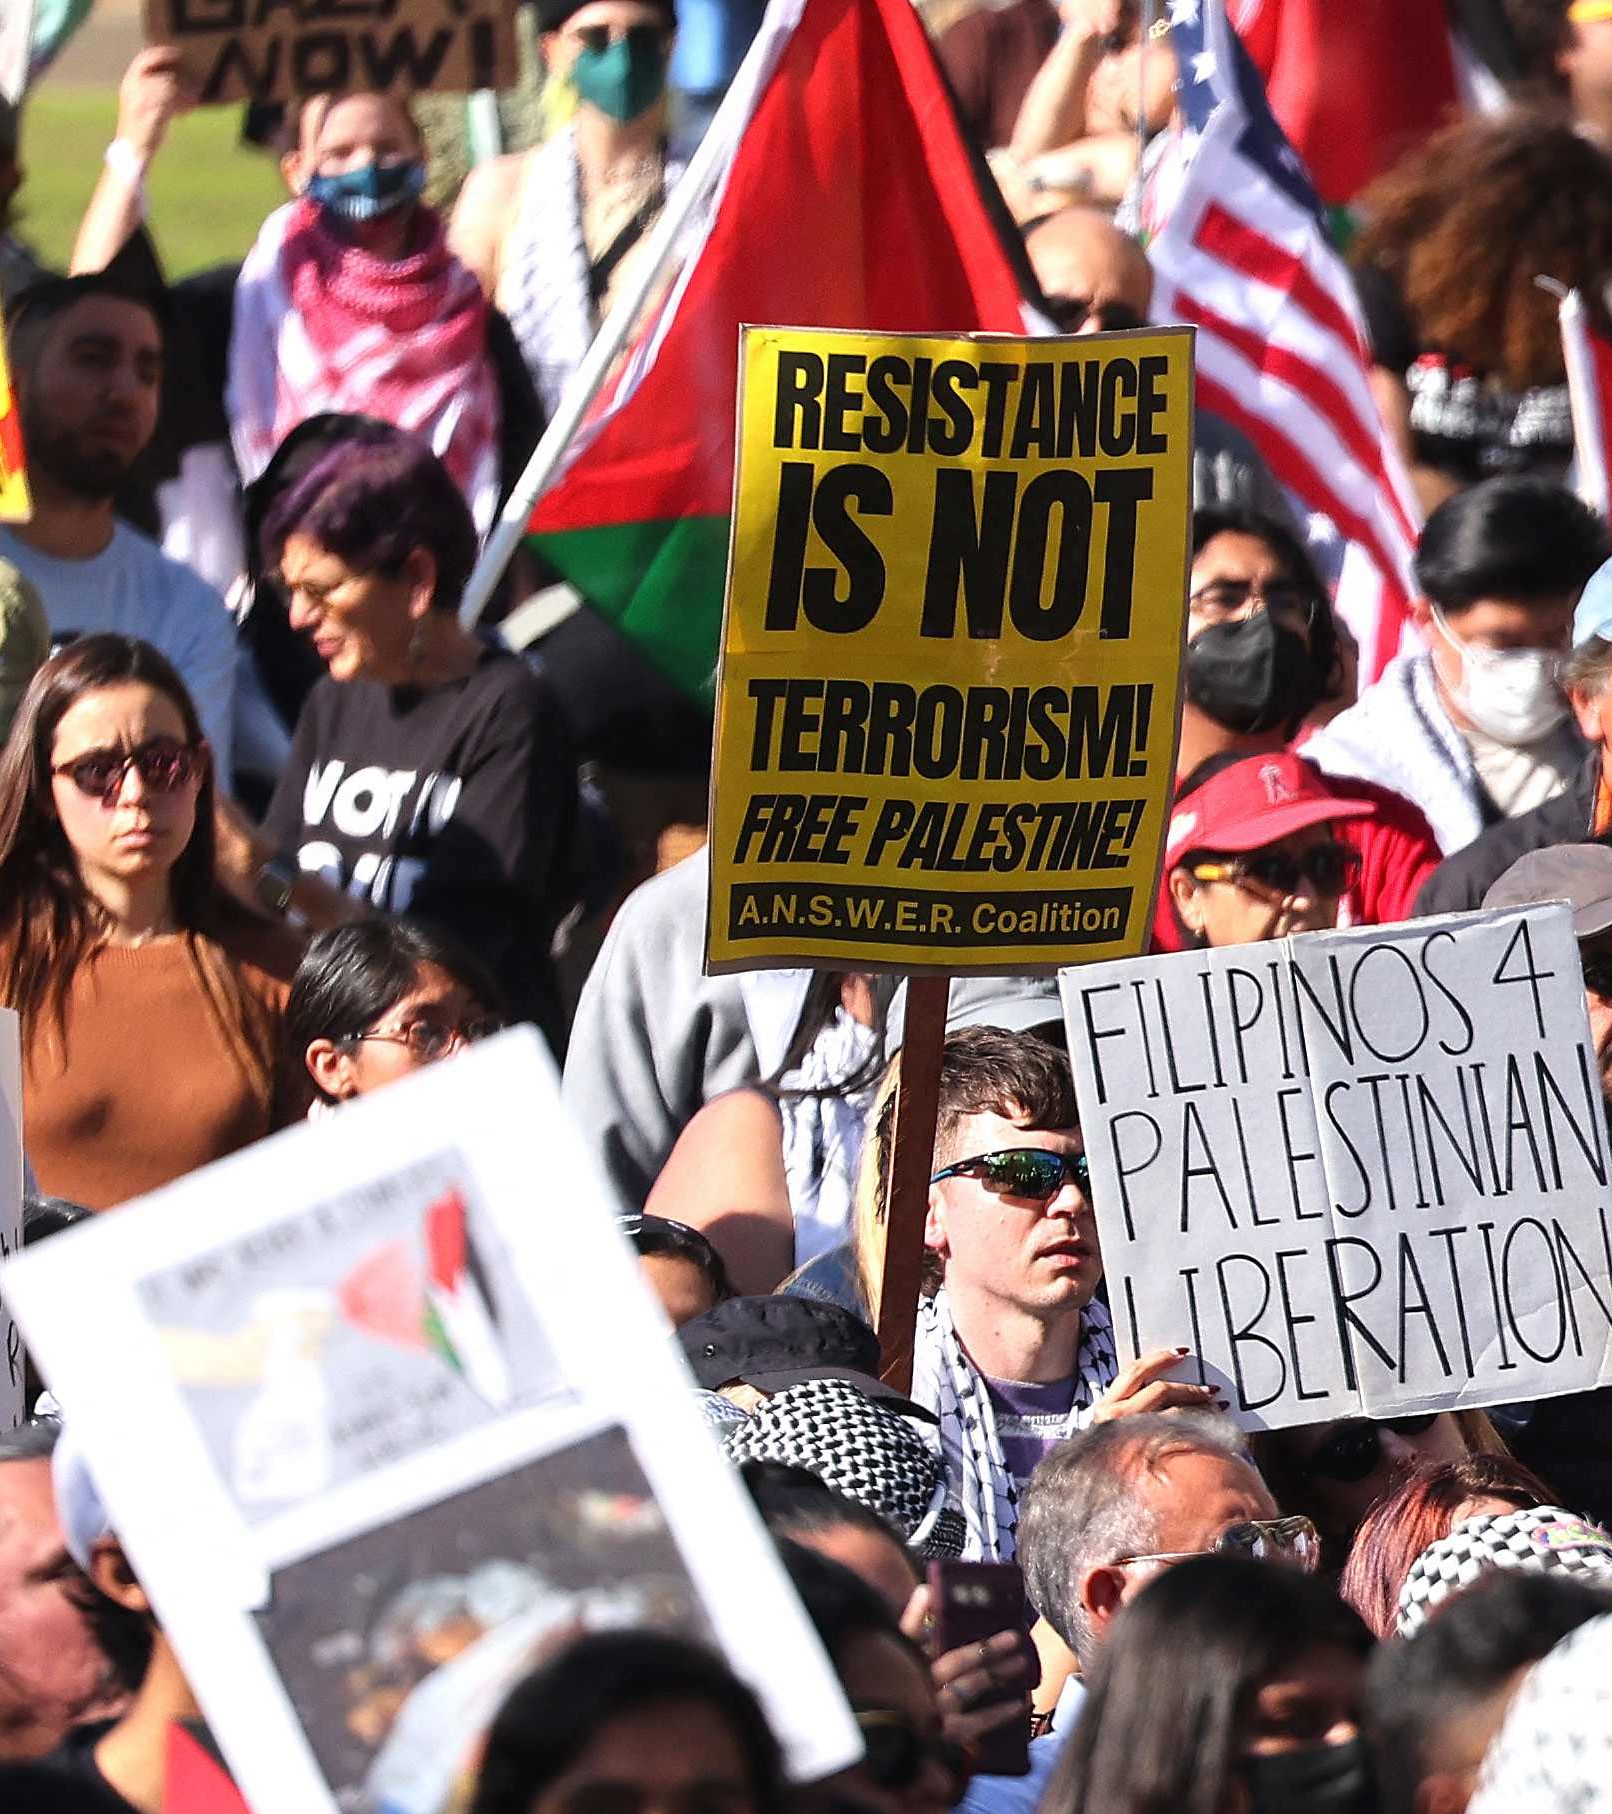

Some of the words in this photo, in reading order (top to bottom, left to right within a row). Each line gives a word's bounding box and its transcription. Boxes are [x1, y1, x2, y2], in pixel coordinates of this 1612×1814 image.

[200, 18, 496, 98] NOW!
[773, 351, 1168, 459] RESISTANCE
[765, 463, 894, 634] IS
[920, 467, 1154, 641] NOT
[748, 678, 1153, 781] TERRORISM!
[733, 794, 867, 866] FREE
[864, 797, 1146, 873] PALESTINE!
[738, 894, 961, 934] A.N.S.W.E.R.
[971, 902, 1120, 935] Coalition
[1081, 931, 1474, 1104] FILIPINOS
[1492, 919, 1555, 1040] 4
[1109, 1042, 1610, 1242] PALESTINIAN
